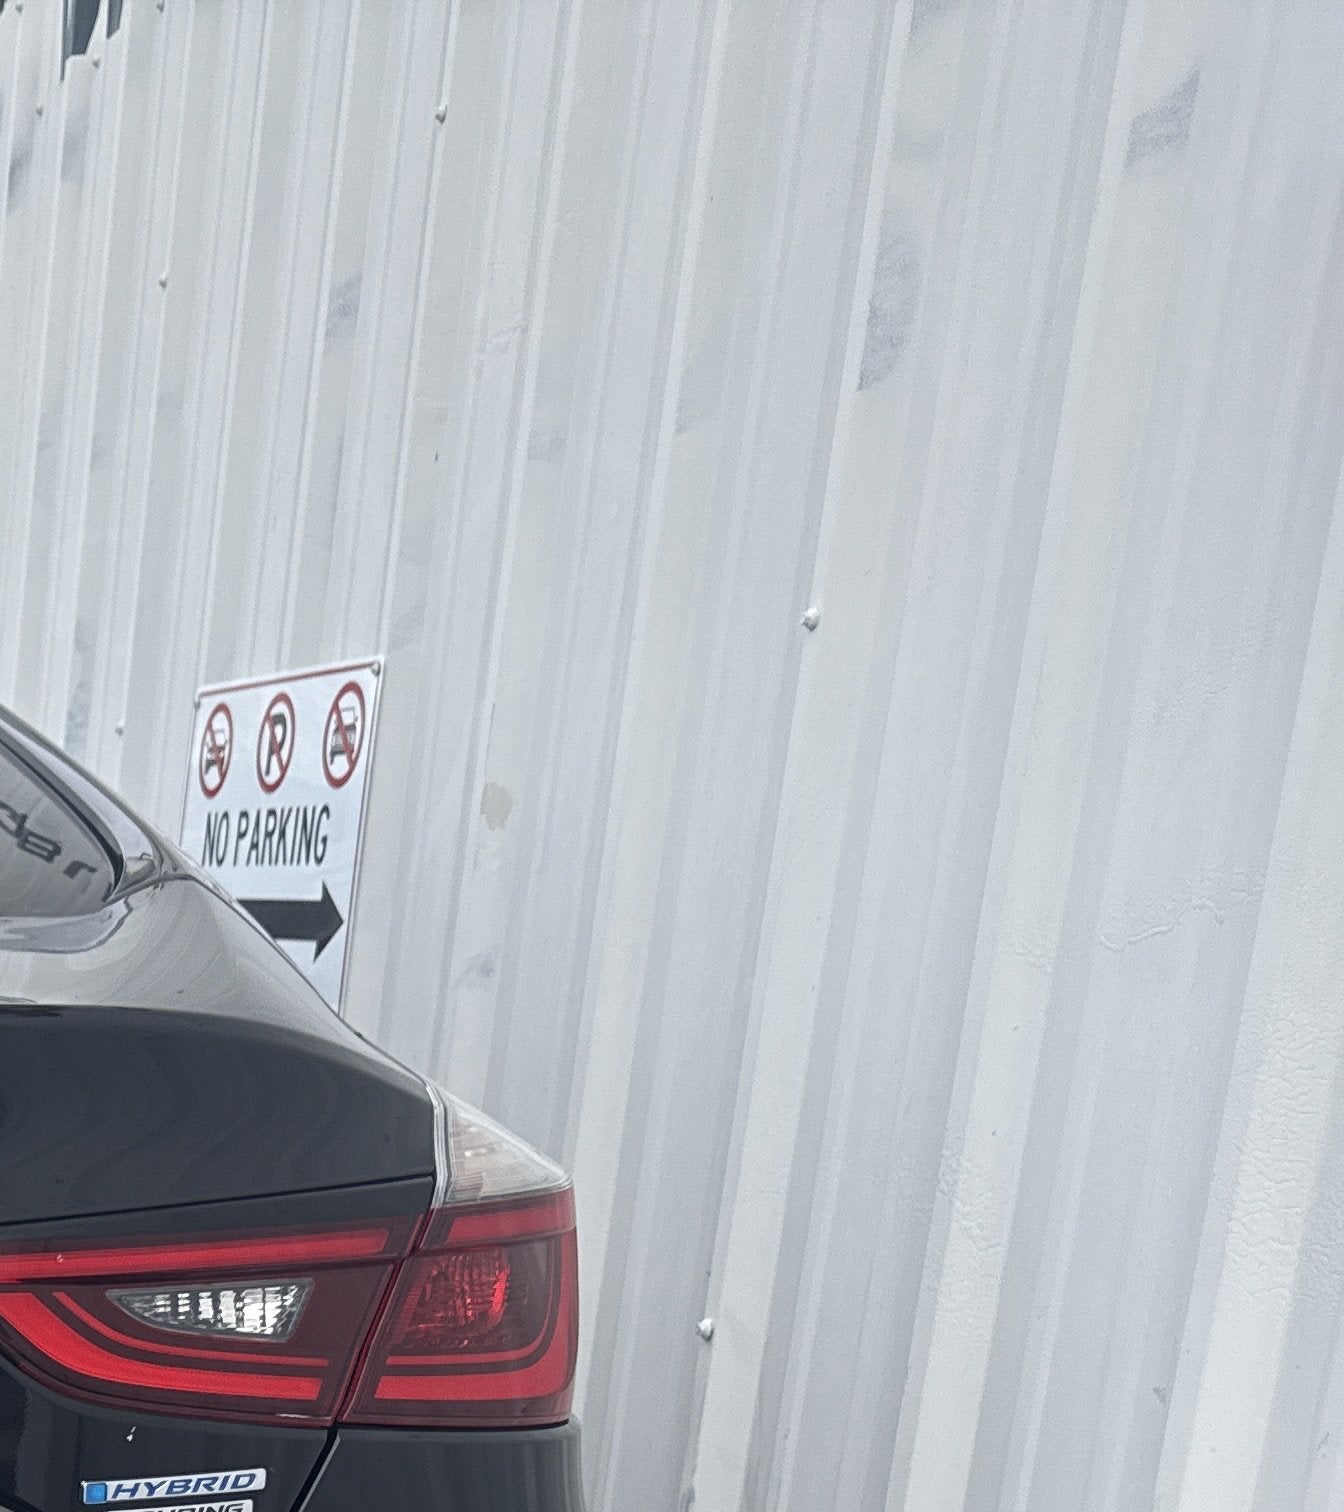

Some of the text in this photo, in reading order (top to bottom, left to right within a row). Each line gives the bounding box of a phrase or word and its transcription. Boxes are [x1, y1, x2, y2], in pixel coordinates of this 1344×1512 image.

[201, 803, 330, 868] NO PARKING
[112, 1473, 256, 1499] HYBRID
